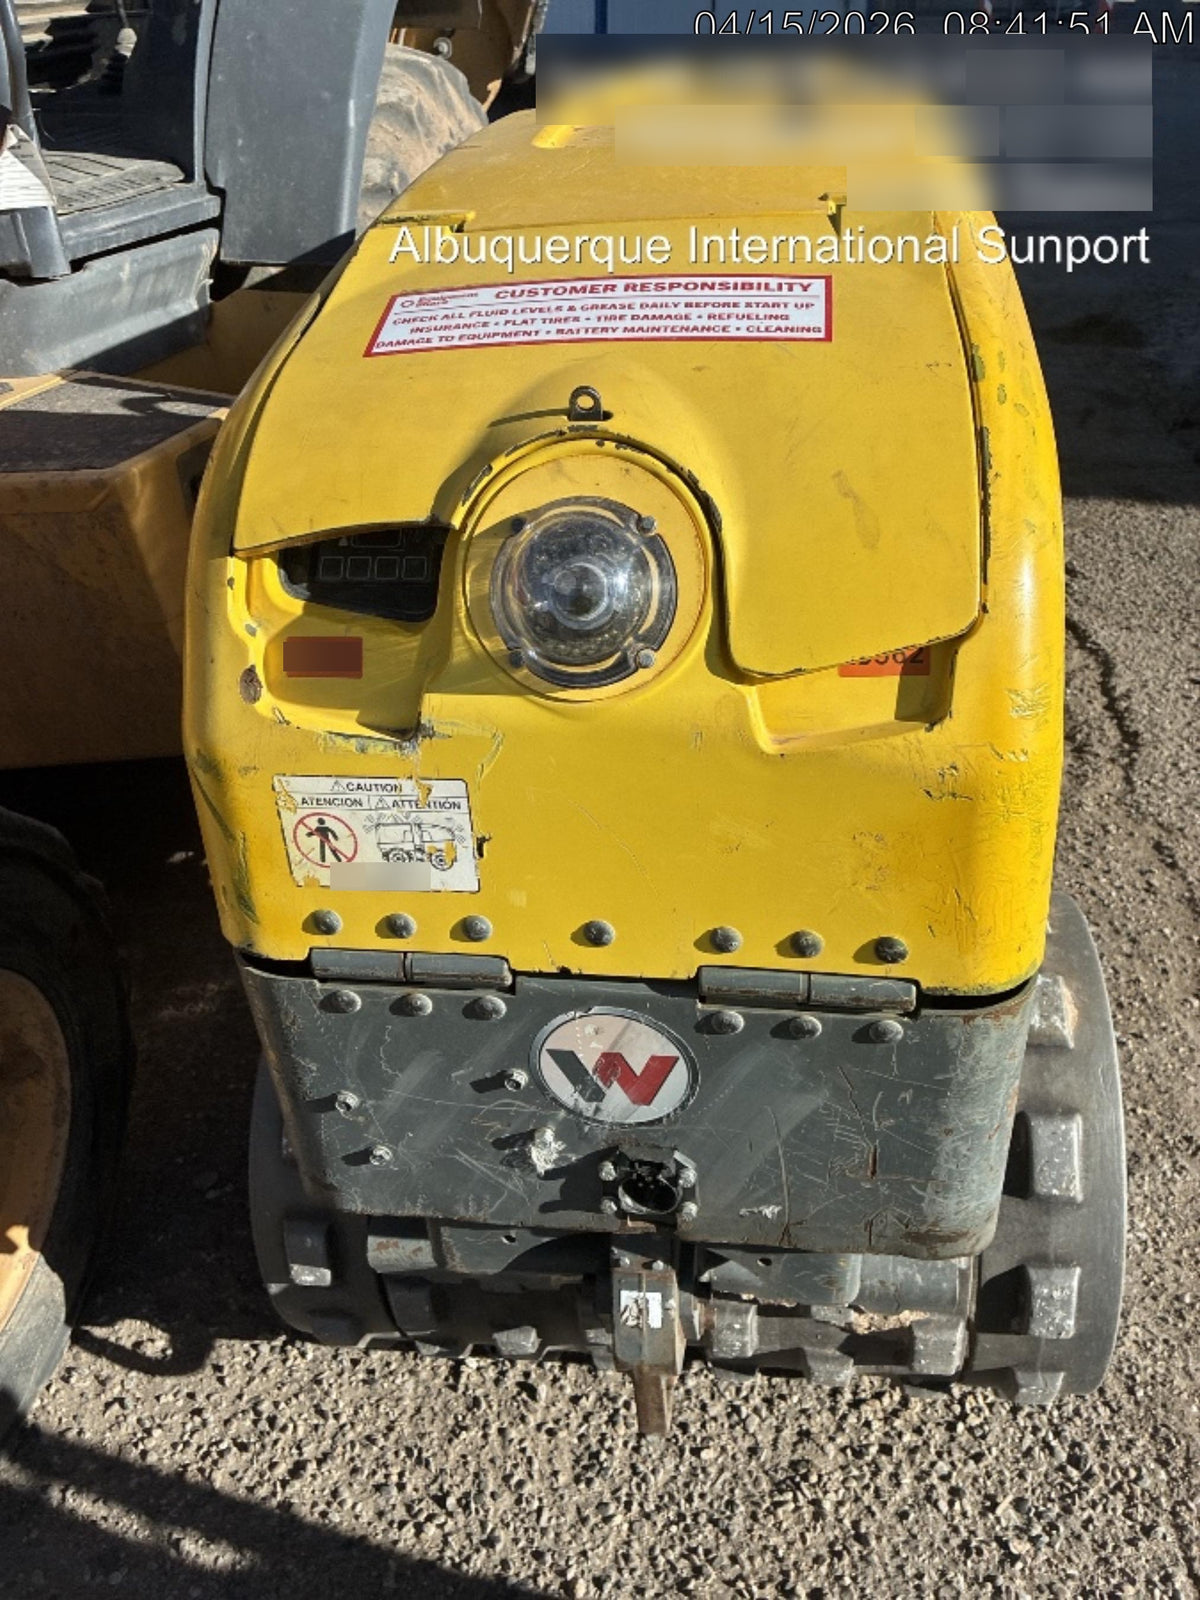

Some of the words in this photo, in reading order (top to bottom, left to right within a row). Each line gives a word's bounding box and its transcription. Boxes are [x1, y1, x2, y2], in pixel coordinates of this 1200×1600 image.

[495, 284, 618, 299] CUSTOMER
[624, 281, 813, 293] RESPONSIBILITY
[392, 315, 439, 326] CHECK
[441, 312, 466, 321] ALL
[469, 308, 510, 318] FLUID
[512, 305, 563, 315] LEVELS
[580, 302, 636, 312] GREASE
[639, 301, 681, 310] DAILY
[684, 301, 741, 309] BEFORE
[744, 301, 790, 309] START
[794, 302, 815, 310] UP
[409, 321, 491, 335] INSURANCE
[503, 317, 537, 327] FLAT
[541, 316, 581, 325] TIRES
[596, 314, 628, 323] TIRE
[630, 313, 693, 322] DAMAGE
[707, 313, 790, 321] REFUELING
[375, 337, 433, 349] DAMAGE
[438, 335, 455, 343] TO
[458, 329, 542, 342] EQUIPMENT
[556, 326, 619, 335] BATTERY
[622, 325, 732, 334] MAINTENANCE
[746, 325, 823, 334] CLEANING
[345, 781, 403, 794] CAUTION
[300, 796, 364, 808] ATENCION
[391, 799, 462, 811] ATTENTION
